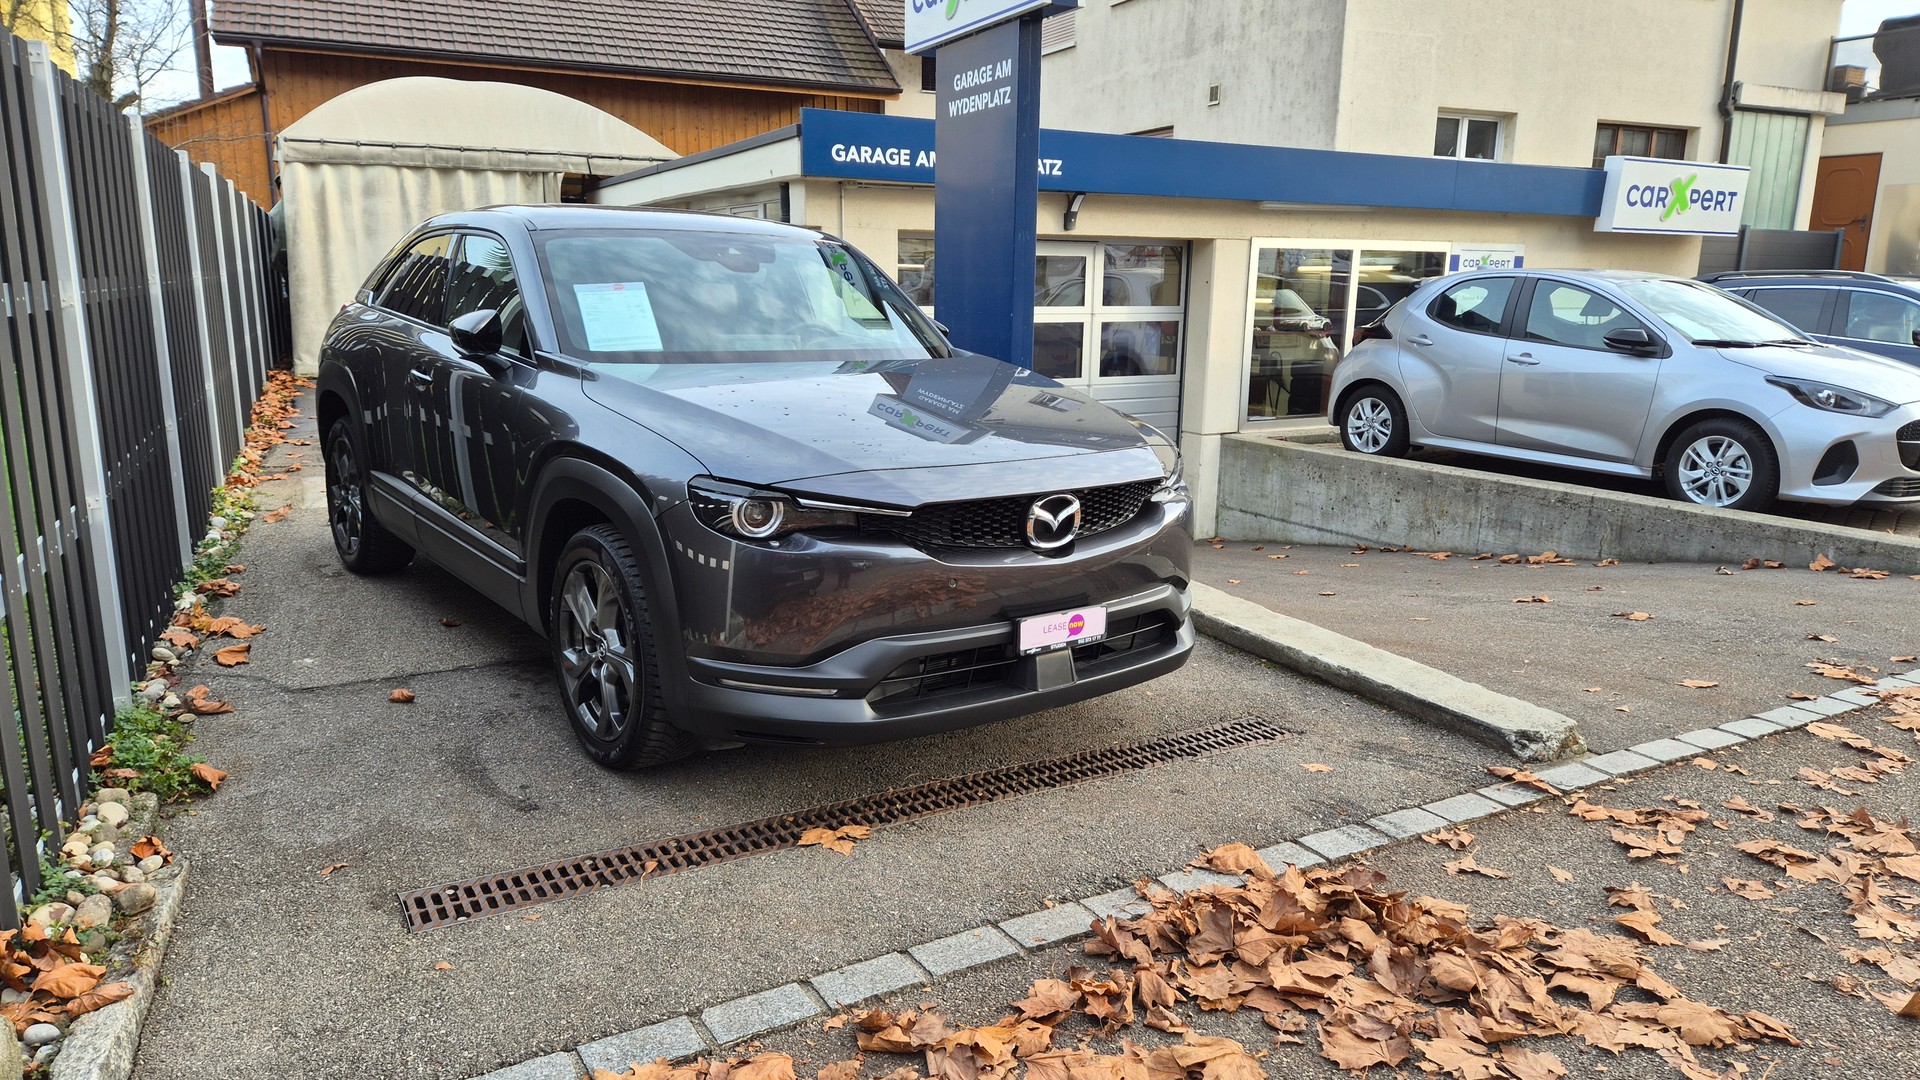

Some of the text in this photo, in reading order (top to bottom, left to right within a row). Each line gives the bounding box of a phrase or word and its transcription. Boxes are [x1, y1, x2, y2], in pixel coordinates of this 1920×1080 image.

[953, 58, 1012, 91] GARAGE AM
[948, 86, 1011, 118] WYDENPLATZ
[831, 143, 911, 166] GARAGE
[1043, 619, 1084, 634] LEASE now
